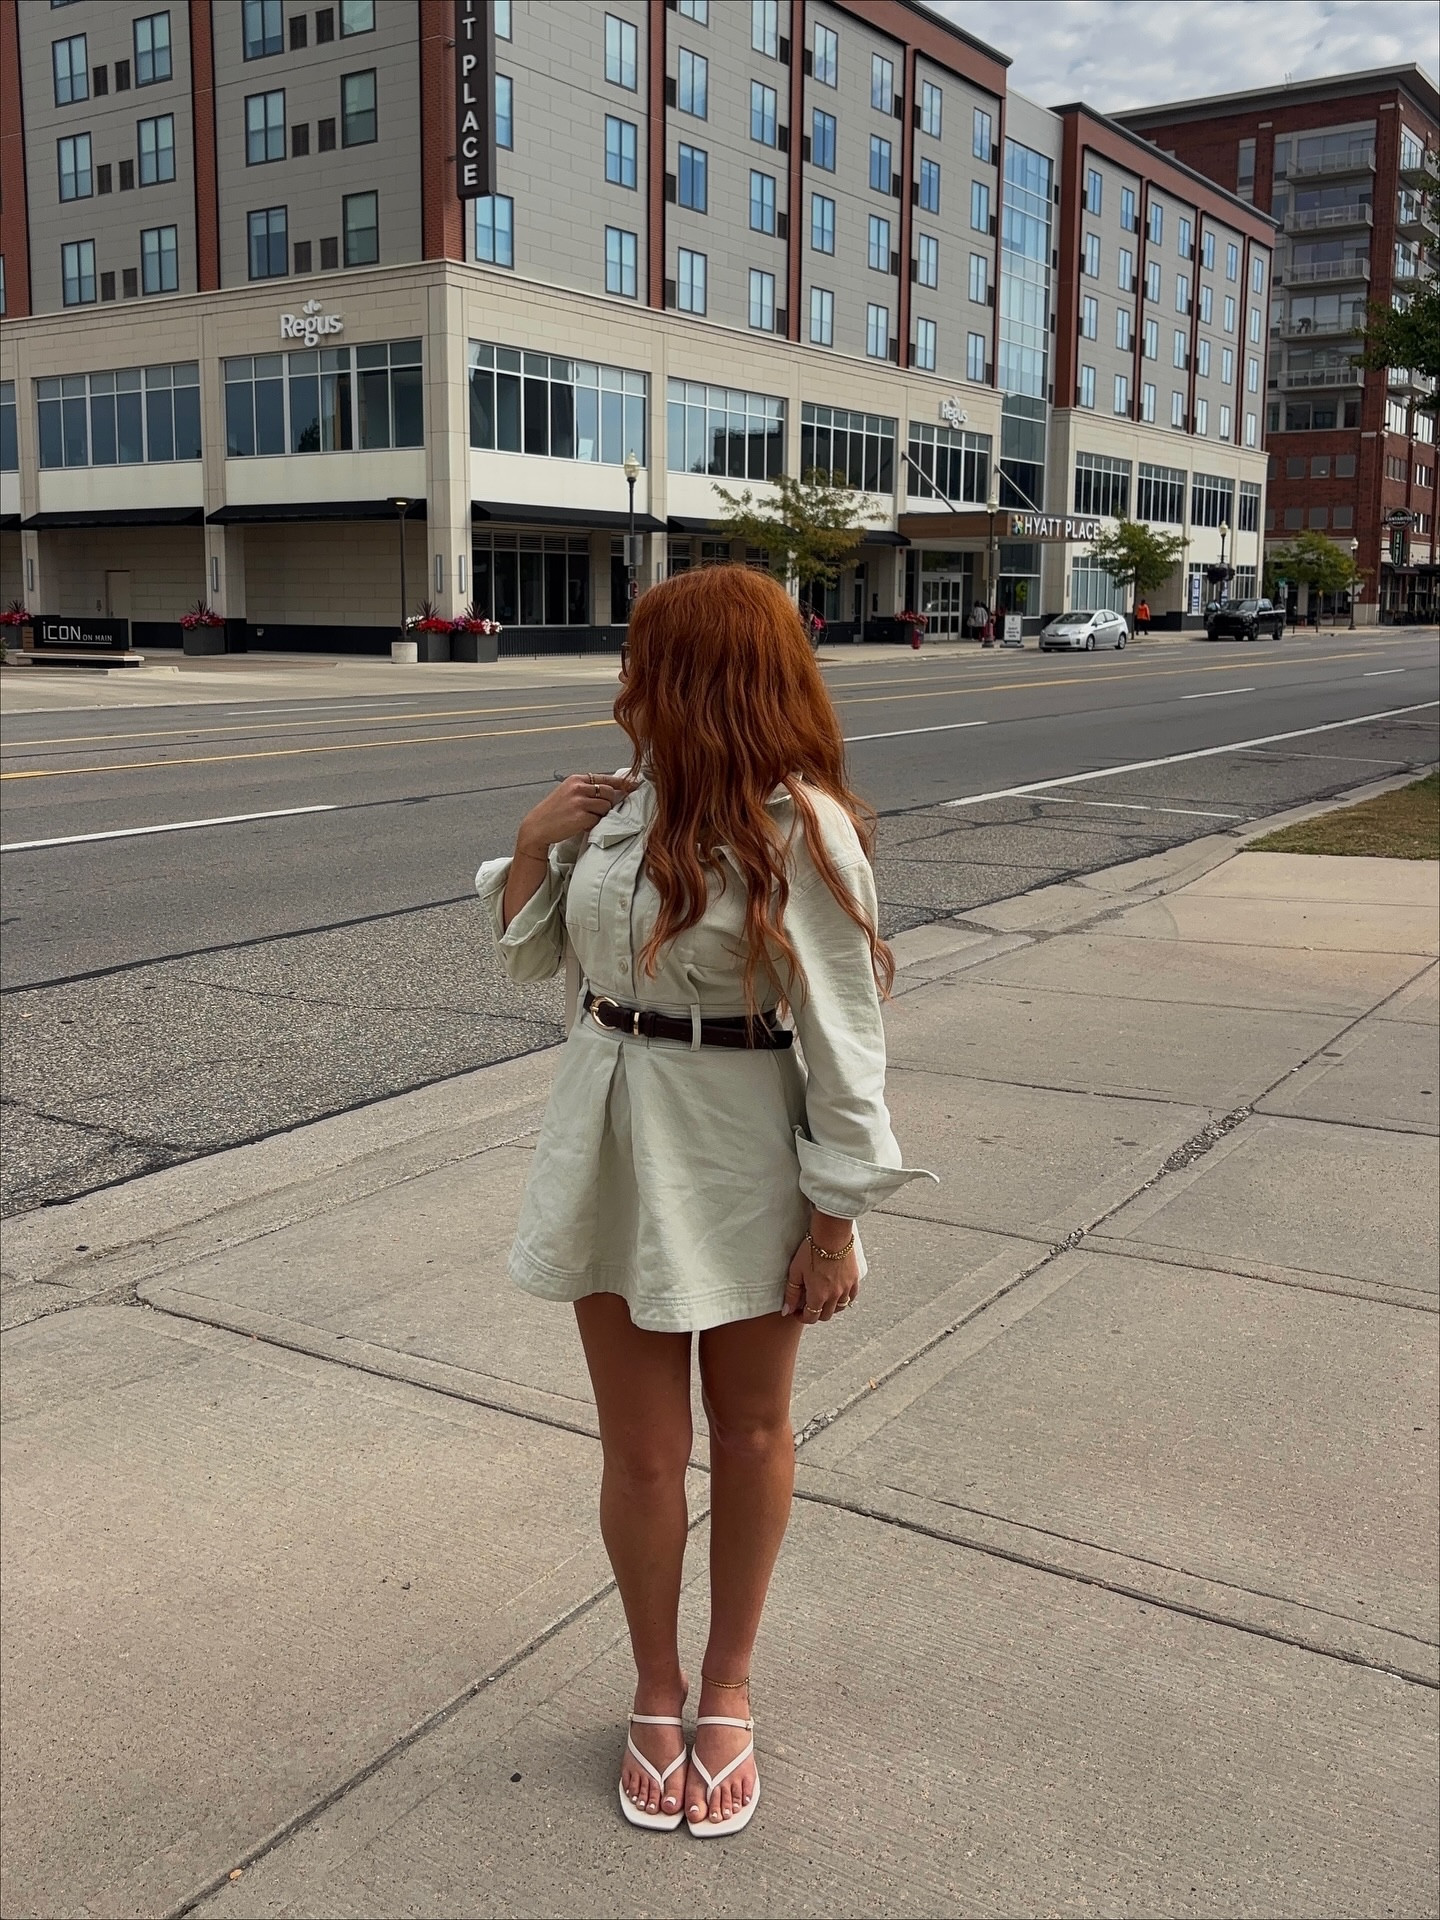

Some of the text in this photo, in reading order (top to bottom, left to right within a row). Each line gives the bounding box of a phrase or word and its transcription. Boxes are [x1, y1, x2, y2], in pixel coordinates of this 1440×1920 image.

[462, 54, 480, 187] PLACE
[281, 313, 344, 347] Regus
[942, 400, 969, 429] Regus
[1024, 516, 1100, 540] HYATT PLACE
